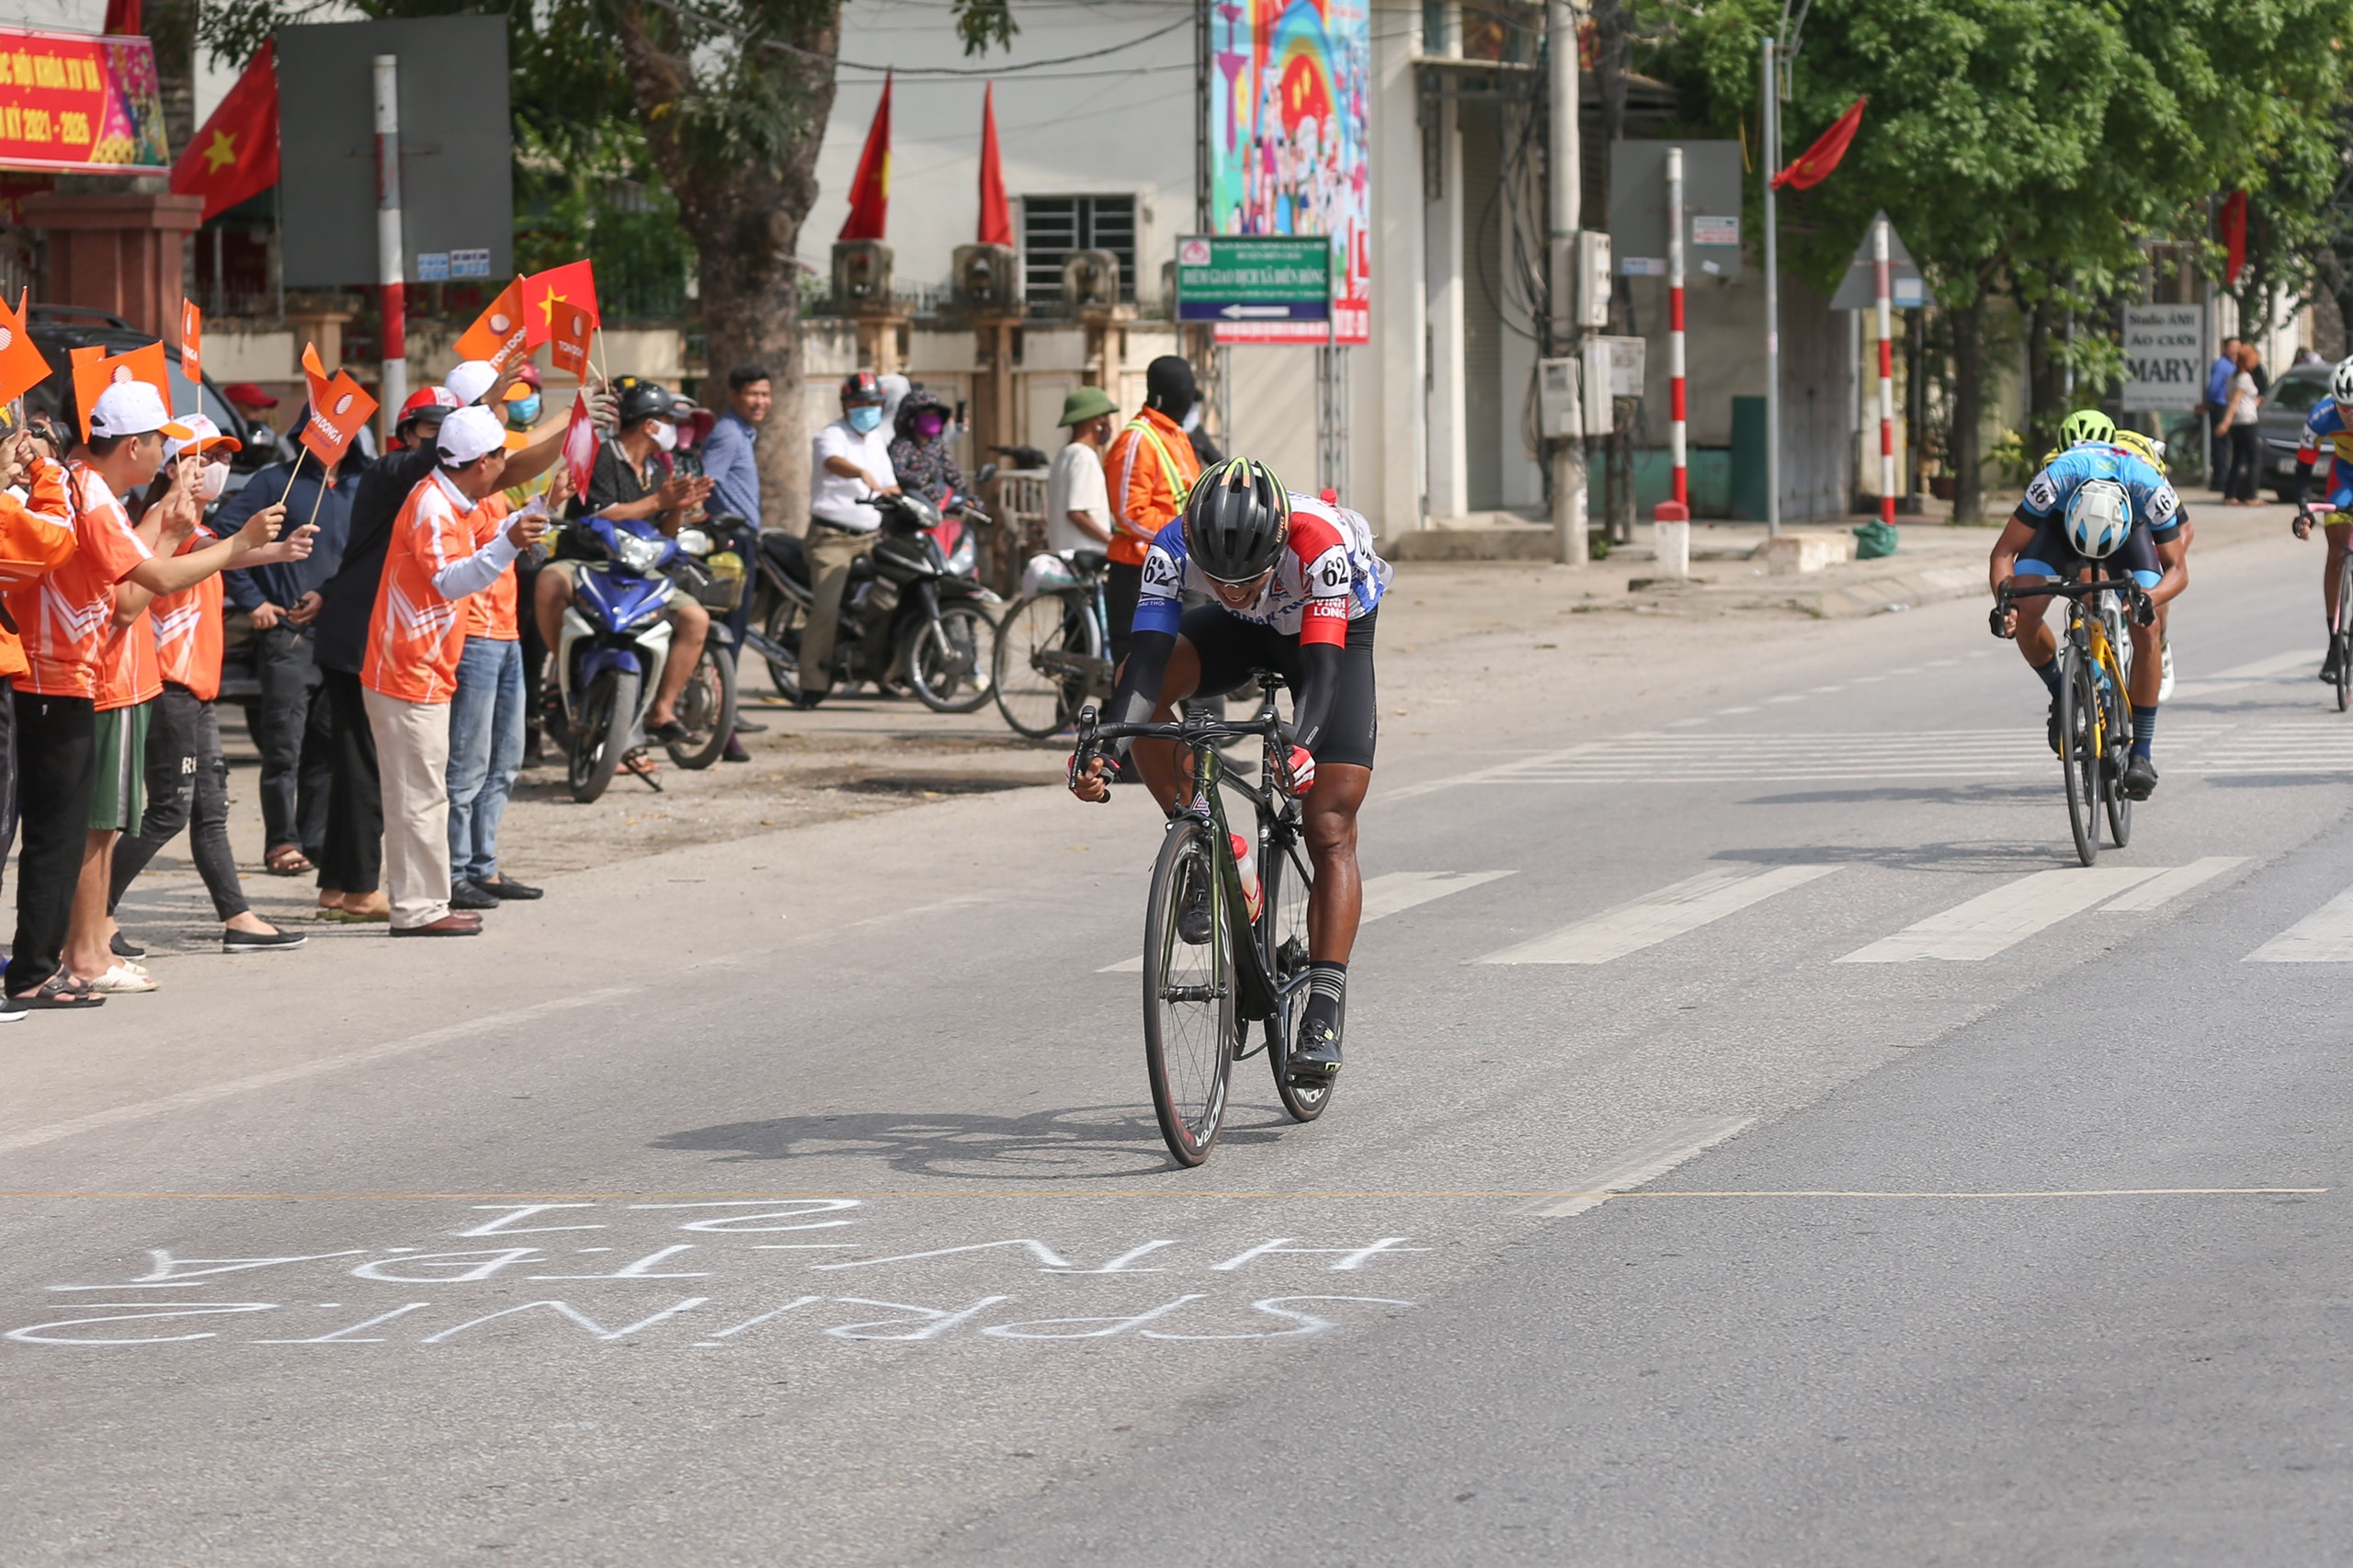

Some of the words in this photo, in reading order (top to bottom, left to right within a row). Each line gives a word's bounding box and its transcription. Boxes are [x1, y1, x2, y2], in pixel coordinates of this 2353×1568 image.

[2127, 358, 2200, 382] MARY
[2029, 483, 2050, 504] 46
[2154, 494, 2172, 517] 46
[1143, 555, 1169, 587] 62
[1322, 555, 1348, 587] 62
[1313, 606, 1347, 620] LONG
